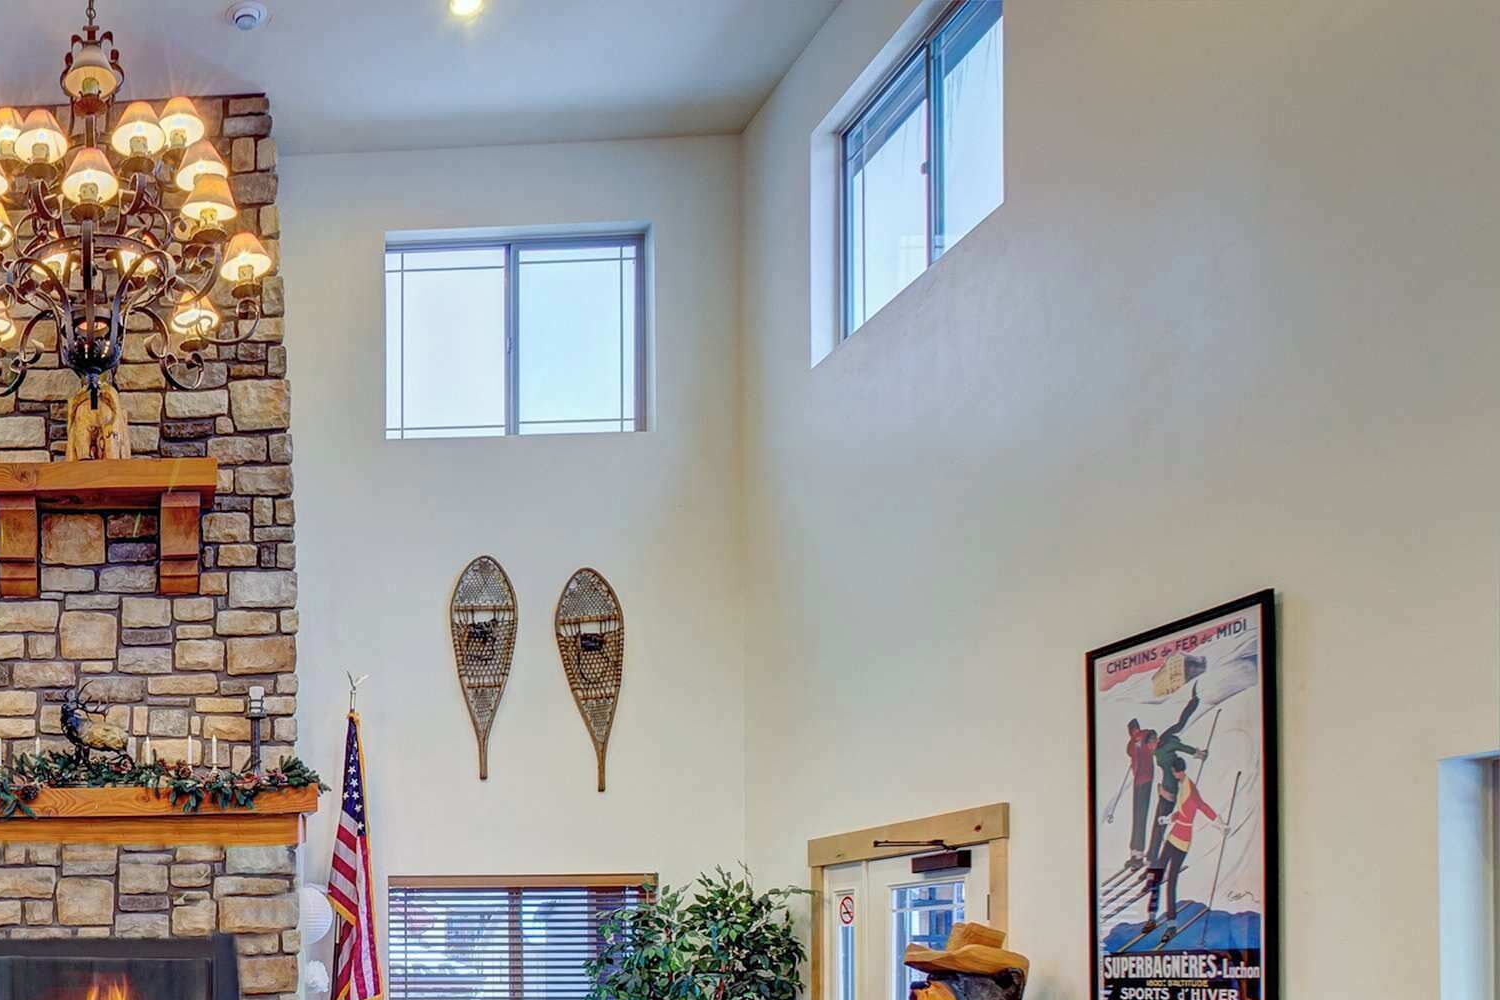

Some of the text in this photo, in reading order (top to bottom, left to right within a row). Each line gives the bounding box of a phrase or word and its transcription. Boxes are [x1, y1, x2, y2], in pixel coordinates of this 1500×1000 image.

[1106, 649, 1158, 674] CHEMINS
[1175, 636, 1199, 652] FER
[1216, 618, 1248, 641] MIDI
[1119, 987, 1170, 1000] SPORTS
